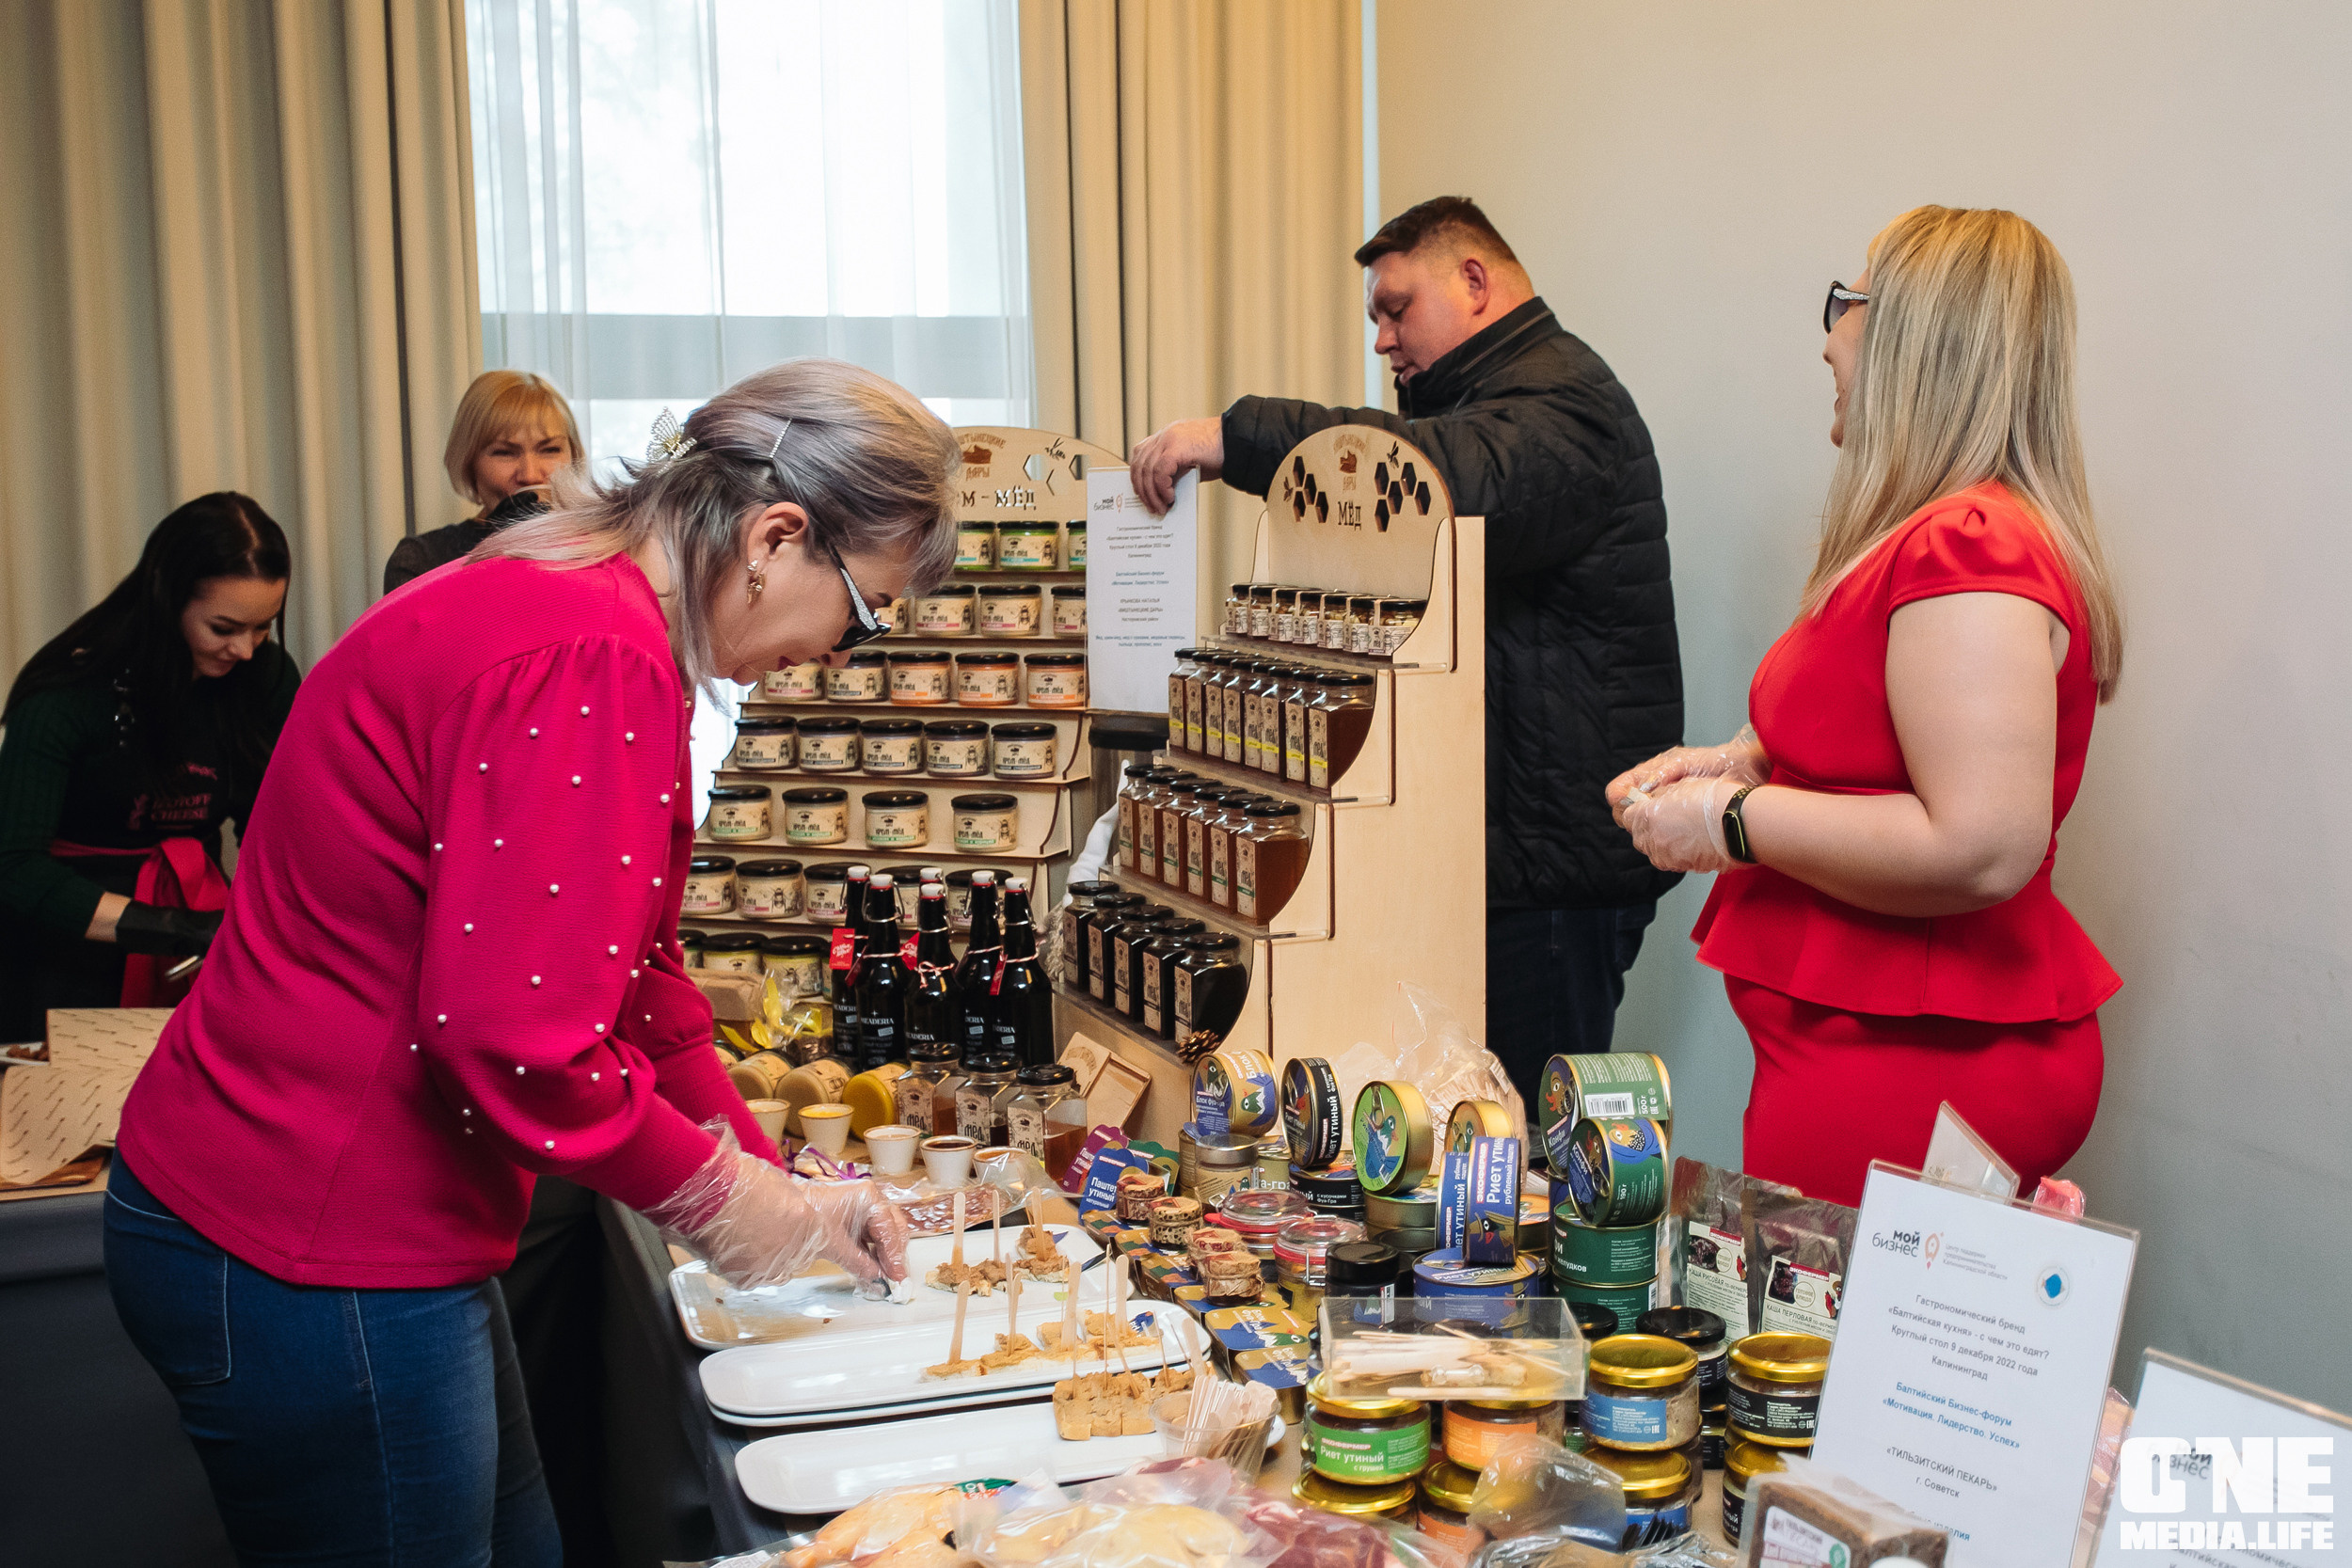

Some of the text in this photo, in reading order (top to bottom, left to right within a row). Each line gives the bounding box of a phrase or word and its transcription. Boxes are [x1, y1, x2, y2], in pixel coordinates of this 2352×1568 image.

[994, 485, 1037, 511] МЁД
[1337, 500, 1362, 531] МЁД
[905, 1033, 935, 1041] EADERIA
[1327, 1095, 1341, 1139] утиный
[1641, 1100, 1649, 1116] 500
[1477, 1142, 1487, 1203] ЭКОФЕРМЕР
[1486, 1136, 1506, 1204] Риет утин
[1571, 1143, 1589, 1176] Конфи
[1088, 1187, 1116, 1203] утиный
[1260, 1179, 1291, 1191] а-гра
[1502, 1162, 1514, 1206] рубленый
[1454, 1184, 1466, 1228] утиный
[1871, 1232, 1919, 1258] бизнес
[1893, 1229, 1921, 1246] мой
[1702, 1273, 1724, 1285] РИСОВАЯ
[1789, 1266, 1830, 1281] ЭКОФЕРМЕР
[1766, 1304, 1781, 1314] КАША
[1782, 1308, 1813, 1323] ПЕРЛОВАЯ
[1915, 1294, 2026, 1336] Гастрономический бренд
[1887, 1306, 1943, 1329] «Балтийская
[1943, 1322, 1973, 1338] кухня»
[1986, 1335, 2004, 1347] чем
[2005, 1340, 2022, 1353] это
[2022, 1346, 2051, 1361] едят?
[1890, 1323, 2039, 1377] Круглый стол 9 декабря 2022 года
[1931, 1354, 1989, 1382] Калининград
[1895, 1381, 2013, 1428] Балтийский Бизнес-форум
[1882, 1396, 2021, 1450] «Мотивация. Лидерство. Успех»
[1320, 1445, 1385, 1465] Риет утиный
[1359, 1464, 1385, 1473] грушей
[1885, 1446, 1998, 1493] «ТИЛЬЗИТСКИЙ ПЕКАРЬ»
[1923, 1477, 1962, 1499] Советск
